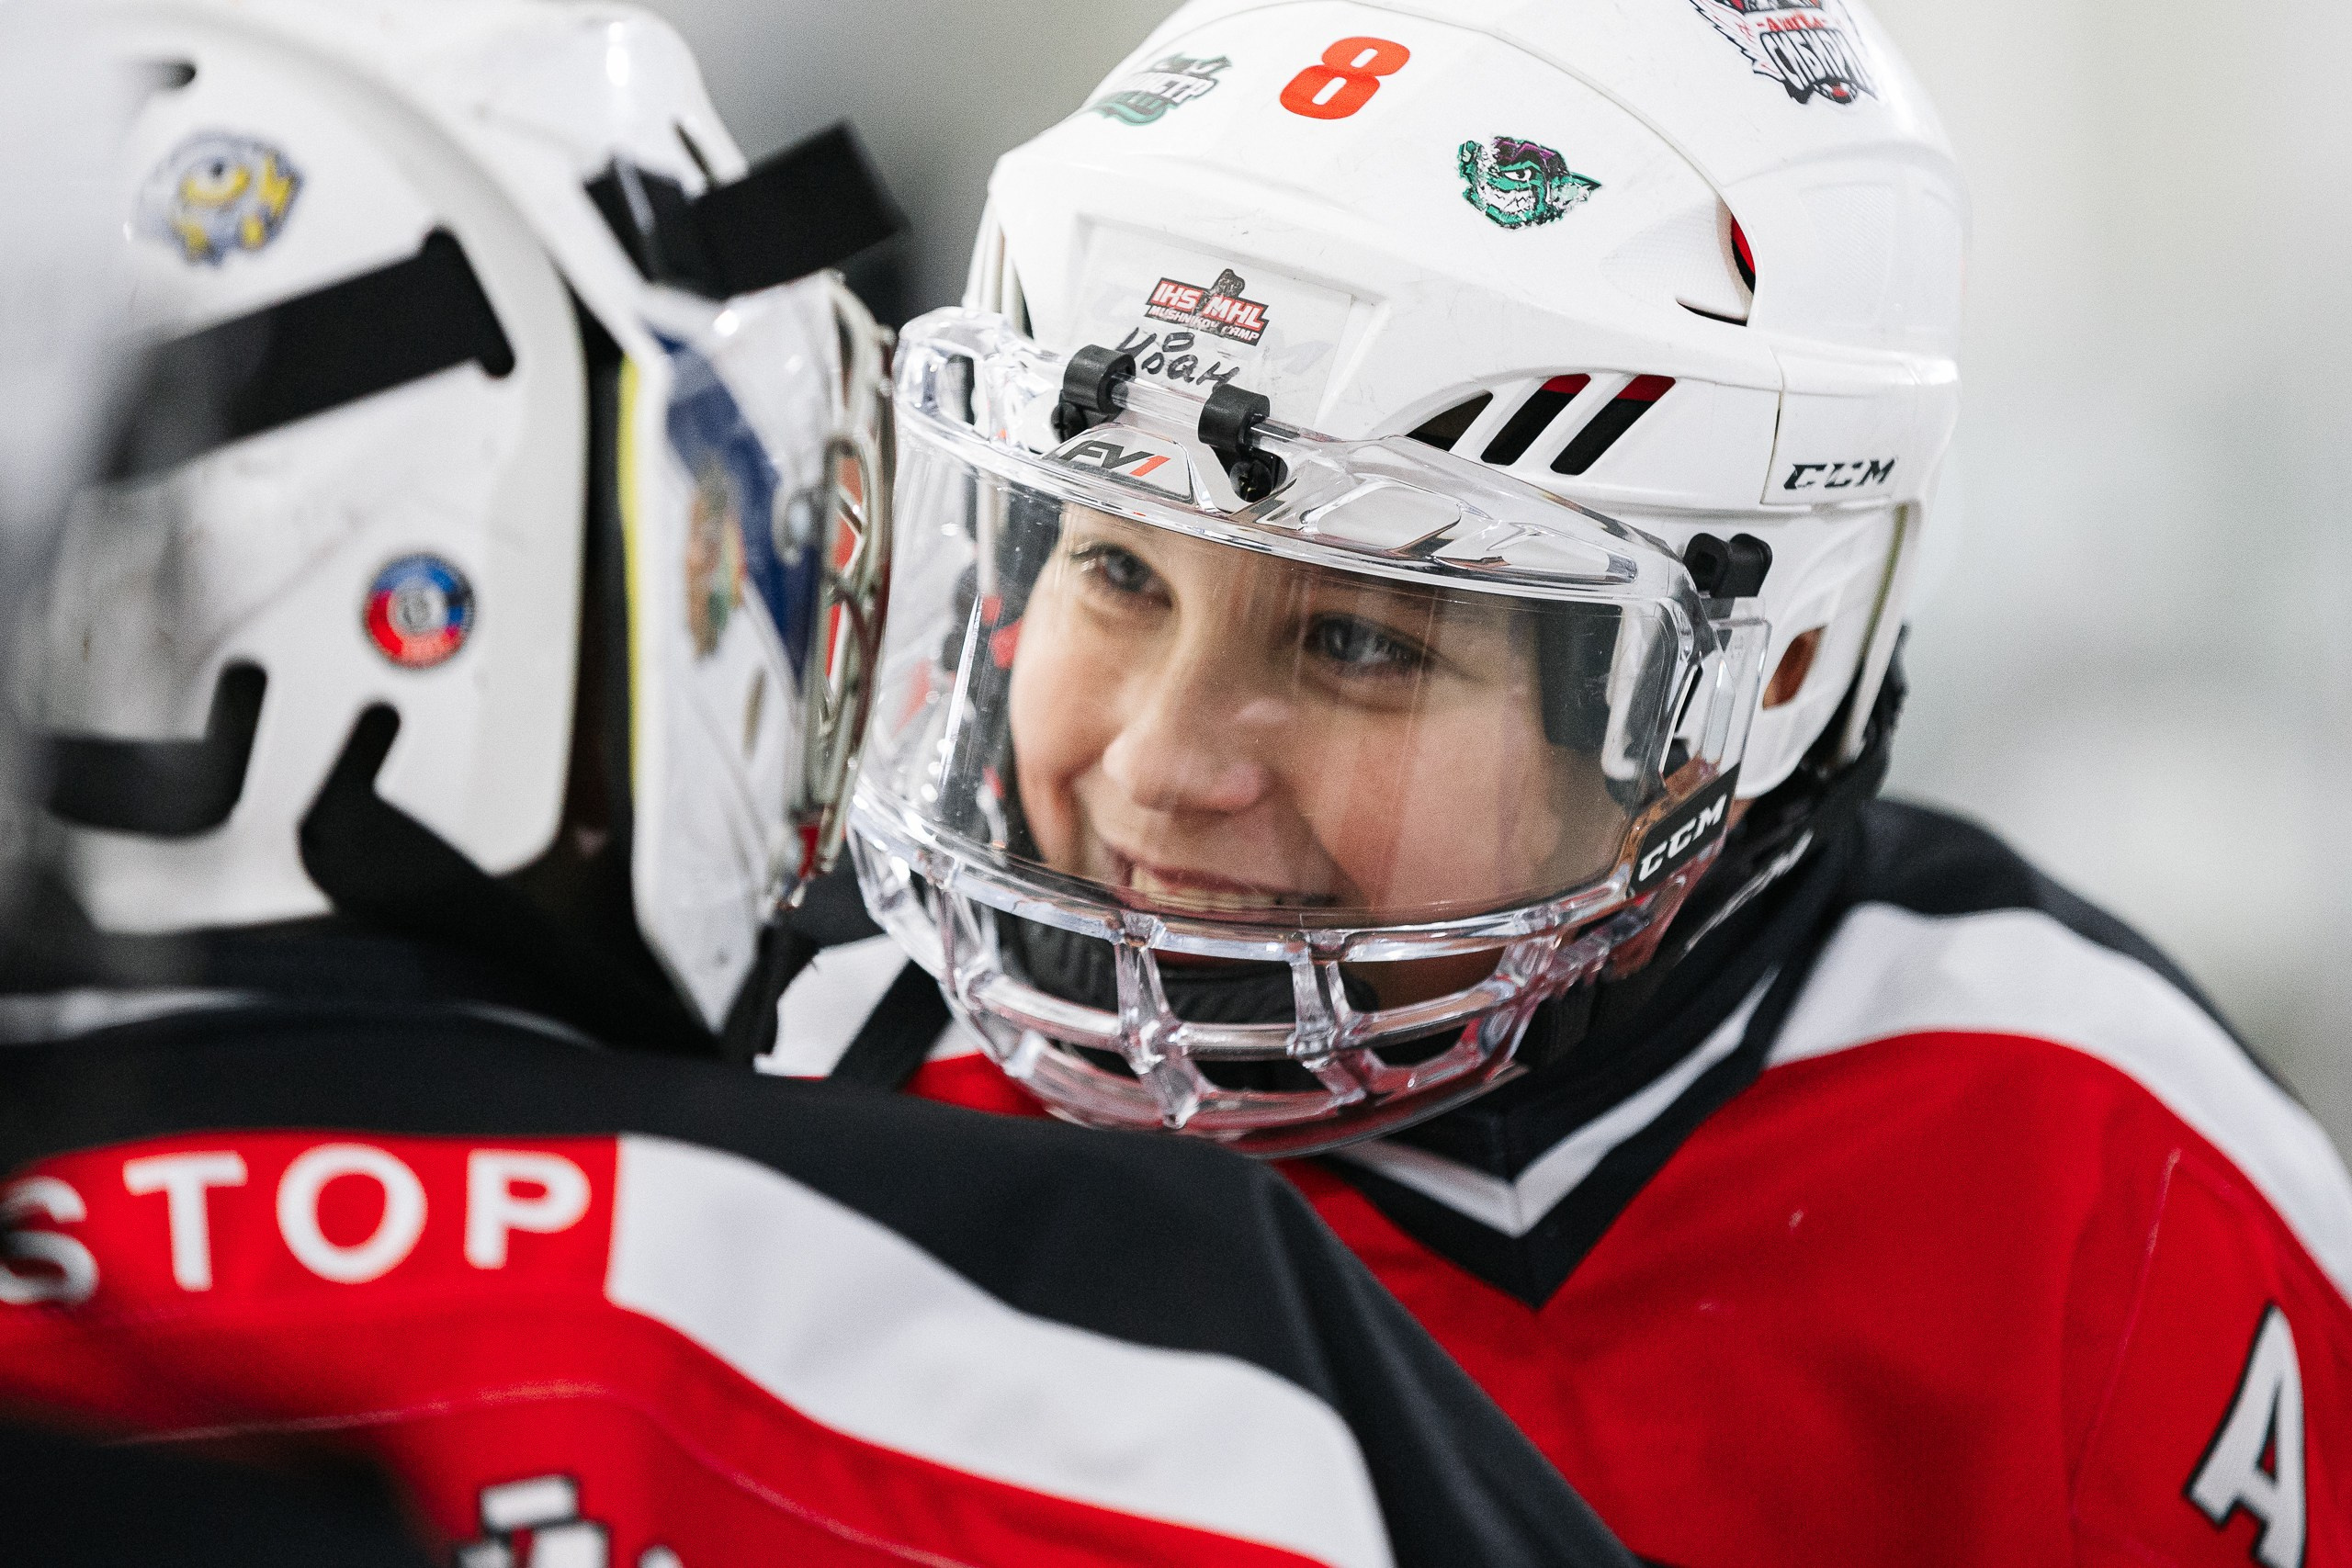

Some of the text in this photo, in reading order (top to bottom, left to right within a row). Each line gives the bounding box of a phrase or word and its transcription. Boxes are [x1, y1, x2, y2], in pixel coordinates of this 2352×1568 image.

[1280, 37, 1410, 119] 8
[1152, 282, 1262, 329] IHS MHL
[1221, 324, 1261, 342] CAMP
[1057, 439, 1171, 478] FV1
[1782, 457, 1897, 491] CCM
[1637, 794, 1728, 882] CCM
[0, 1142, 592, 1307] STOP
[2181, 1298, 2310, 1568] A
